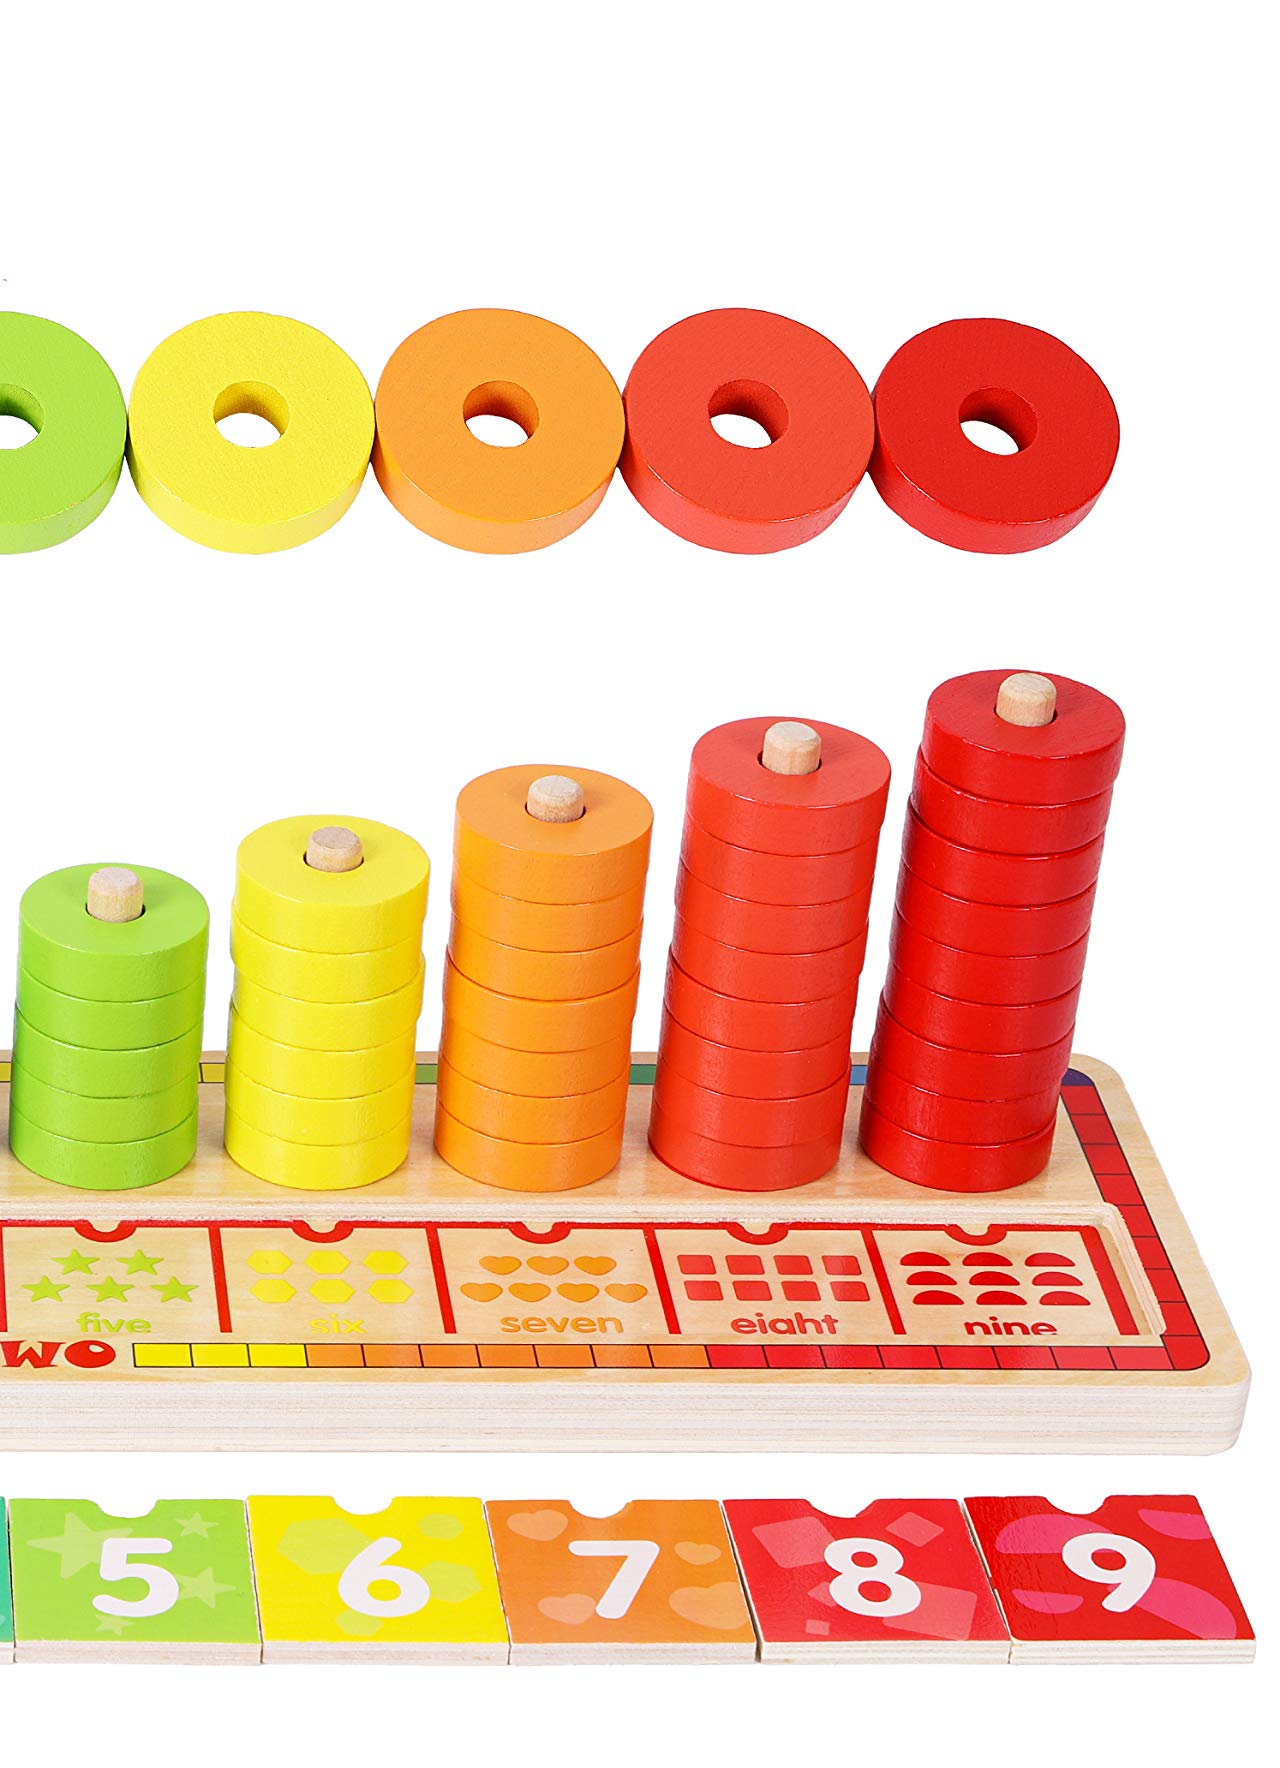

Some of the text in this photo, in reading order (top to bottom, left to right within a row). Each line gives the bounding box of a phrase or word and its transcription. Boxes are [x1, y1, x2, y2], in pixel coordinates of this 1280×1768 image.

[75, 1311, 151, 1334] five
[309, 1313, 366, 1335] six
[500, 1315, 623, 1334] seven
[964, 1315, 1058, 1336] nine
[91, 1538, 180, 1616] 5
[338, 1537, 430, 1616] 6
[568, 1540, 660, 1620] 7
[827, 1538, 923, 1617] 8
[1061, 1533, 1156, 1612] 9
